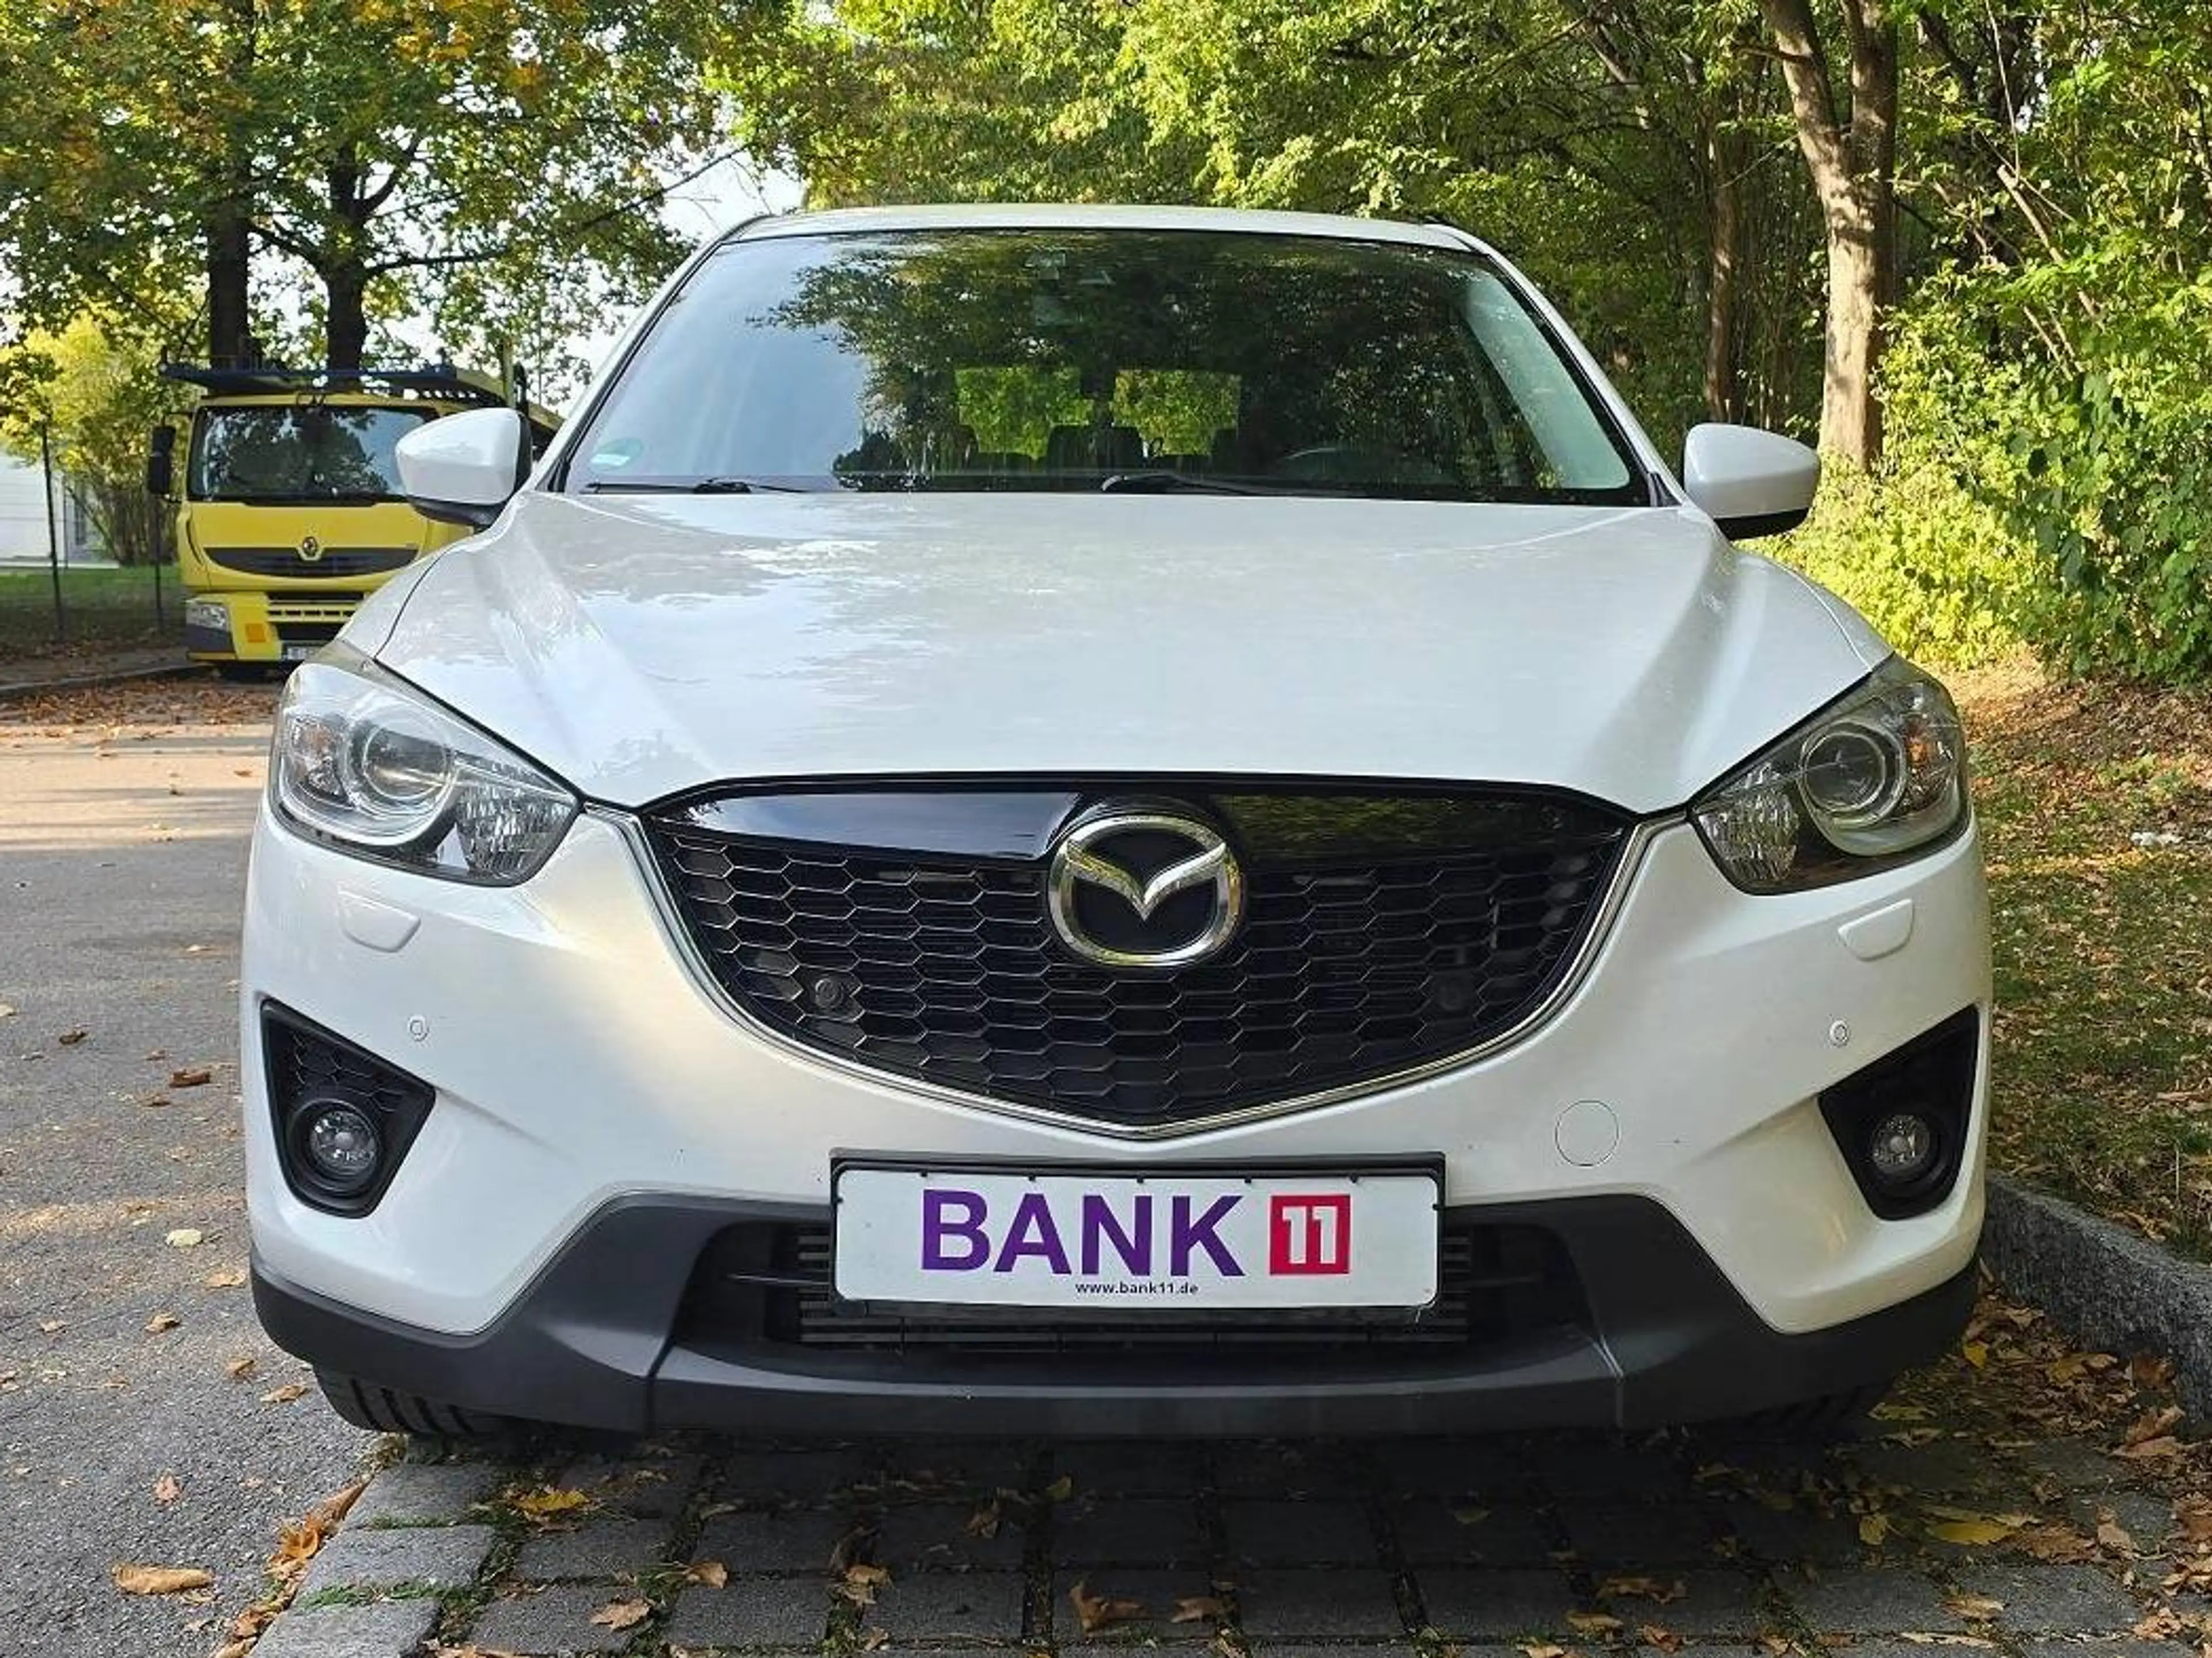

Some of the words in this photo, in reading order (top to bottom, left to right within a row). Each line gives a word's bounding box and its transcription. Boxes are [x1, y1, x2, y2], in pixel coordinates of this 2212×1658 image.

[921, 1189, 1245, 1277] BANK
[1282, 1205, 1338, 1264] 11
[1075, 1281, 1199, 1294] www.bank11.de
